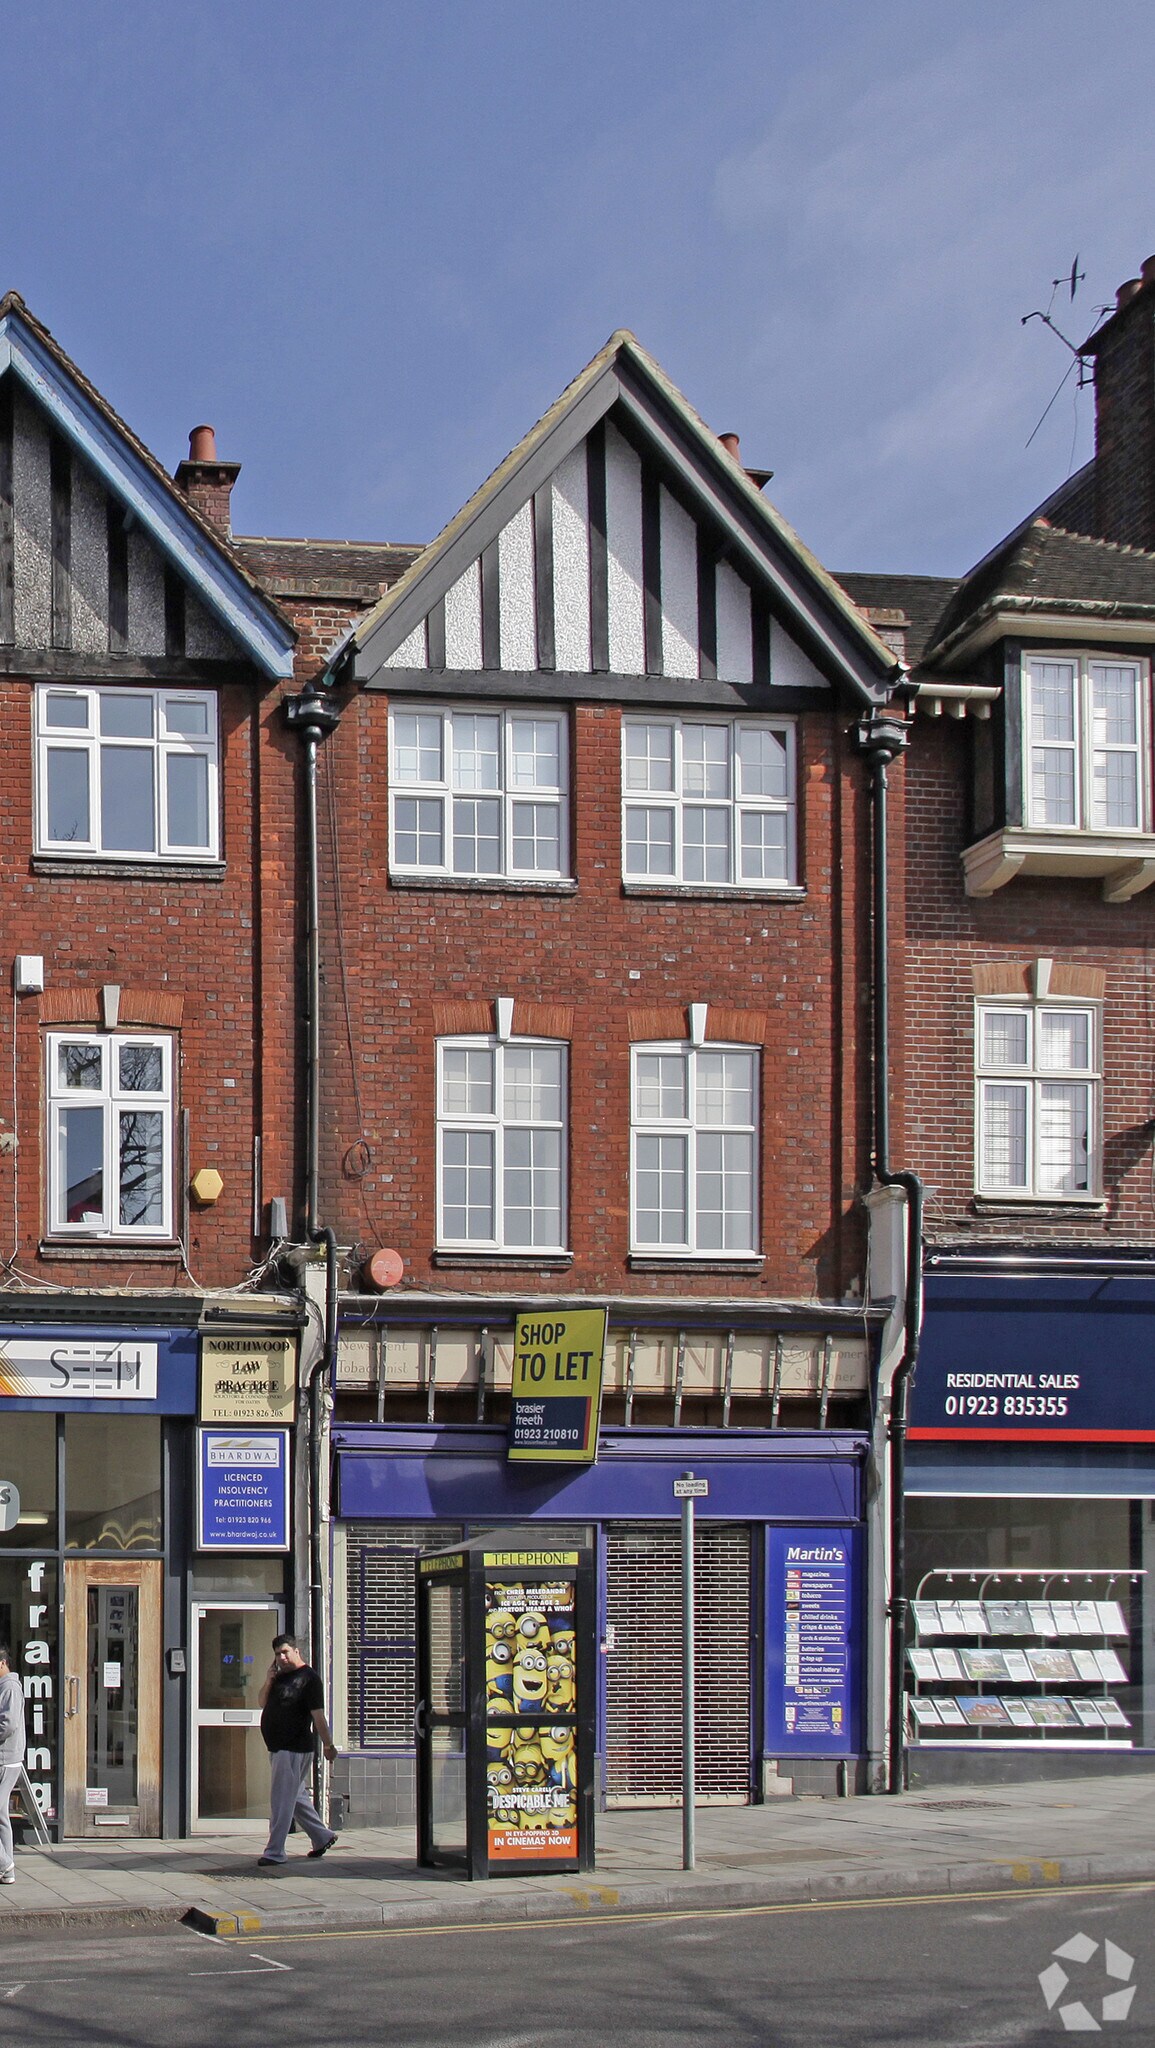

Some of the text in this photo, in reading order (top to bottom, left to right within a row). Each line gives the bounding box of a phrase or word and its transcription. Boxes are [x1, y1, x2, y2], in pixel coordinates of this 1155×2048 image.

[520, 1323, 566, 1346] SHOP
[209, 1341, 290, 1352] NORTHWOOD
[339, 1337, 408, 1351] Newsaent
[232, 1361, 262, 1374] LAW
[338, 1360, 408, 1374] Tobaccnist
[518, 1352, 593, 1381] TO LET
[215, 1380, 279, 1393] PRACTICE
[947, 1373, 1080, 1389] RESIDENTIAL SALES
[516, 1402, 545, 1413] brasier
[945, 1396, 1068, 1416] 01923 835355
[213, 1409, 283, 1417] TEL: 01923 826 208
[515, 1415, 543, 1425] freeth
[514, 1429, 579, 1440] 01923 210810
[210, 1452, 278, 1460] BHARDWAJ
[224, 1473, 263, 1481] LICENCED
[218, 1486, 268, 1494] INSOLVENCY
[214, 1499, 272, 1507] PRACTITIONERS
[227, 1516, 246, 1524] 01923
[247, 1516, 259, 1524] 820
[260, 1516, 272, 1524] 966
[209, 1531, 277, 1539] www.bhardwaj.co.uk
[493, 1552, 570, 1565] TELEPHONE
[787, 1547, 844, 1560] Martin's
[424, 1556, 459, 1572] TELEPHONE
[223, 1655, 234, 1664] 47
[23, 1562, 53, 1813] framing
[493, 1794, 570, 1809] DESPICABLE ME
[494, 1836, 571, 1846] IN CINEMAS NOW
